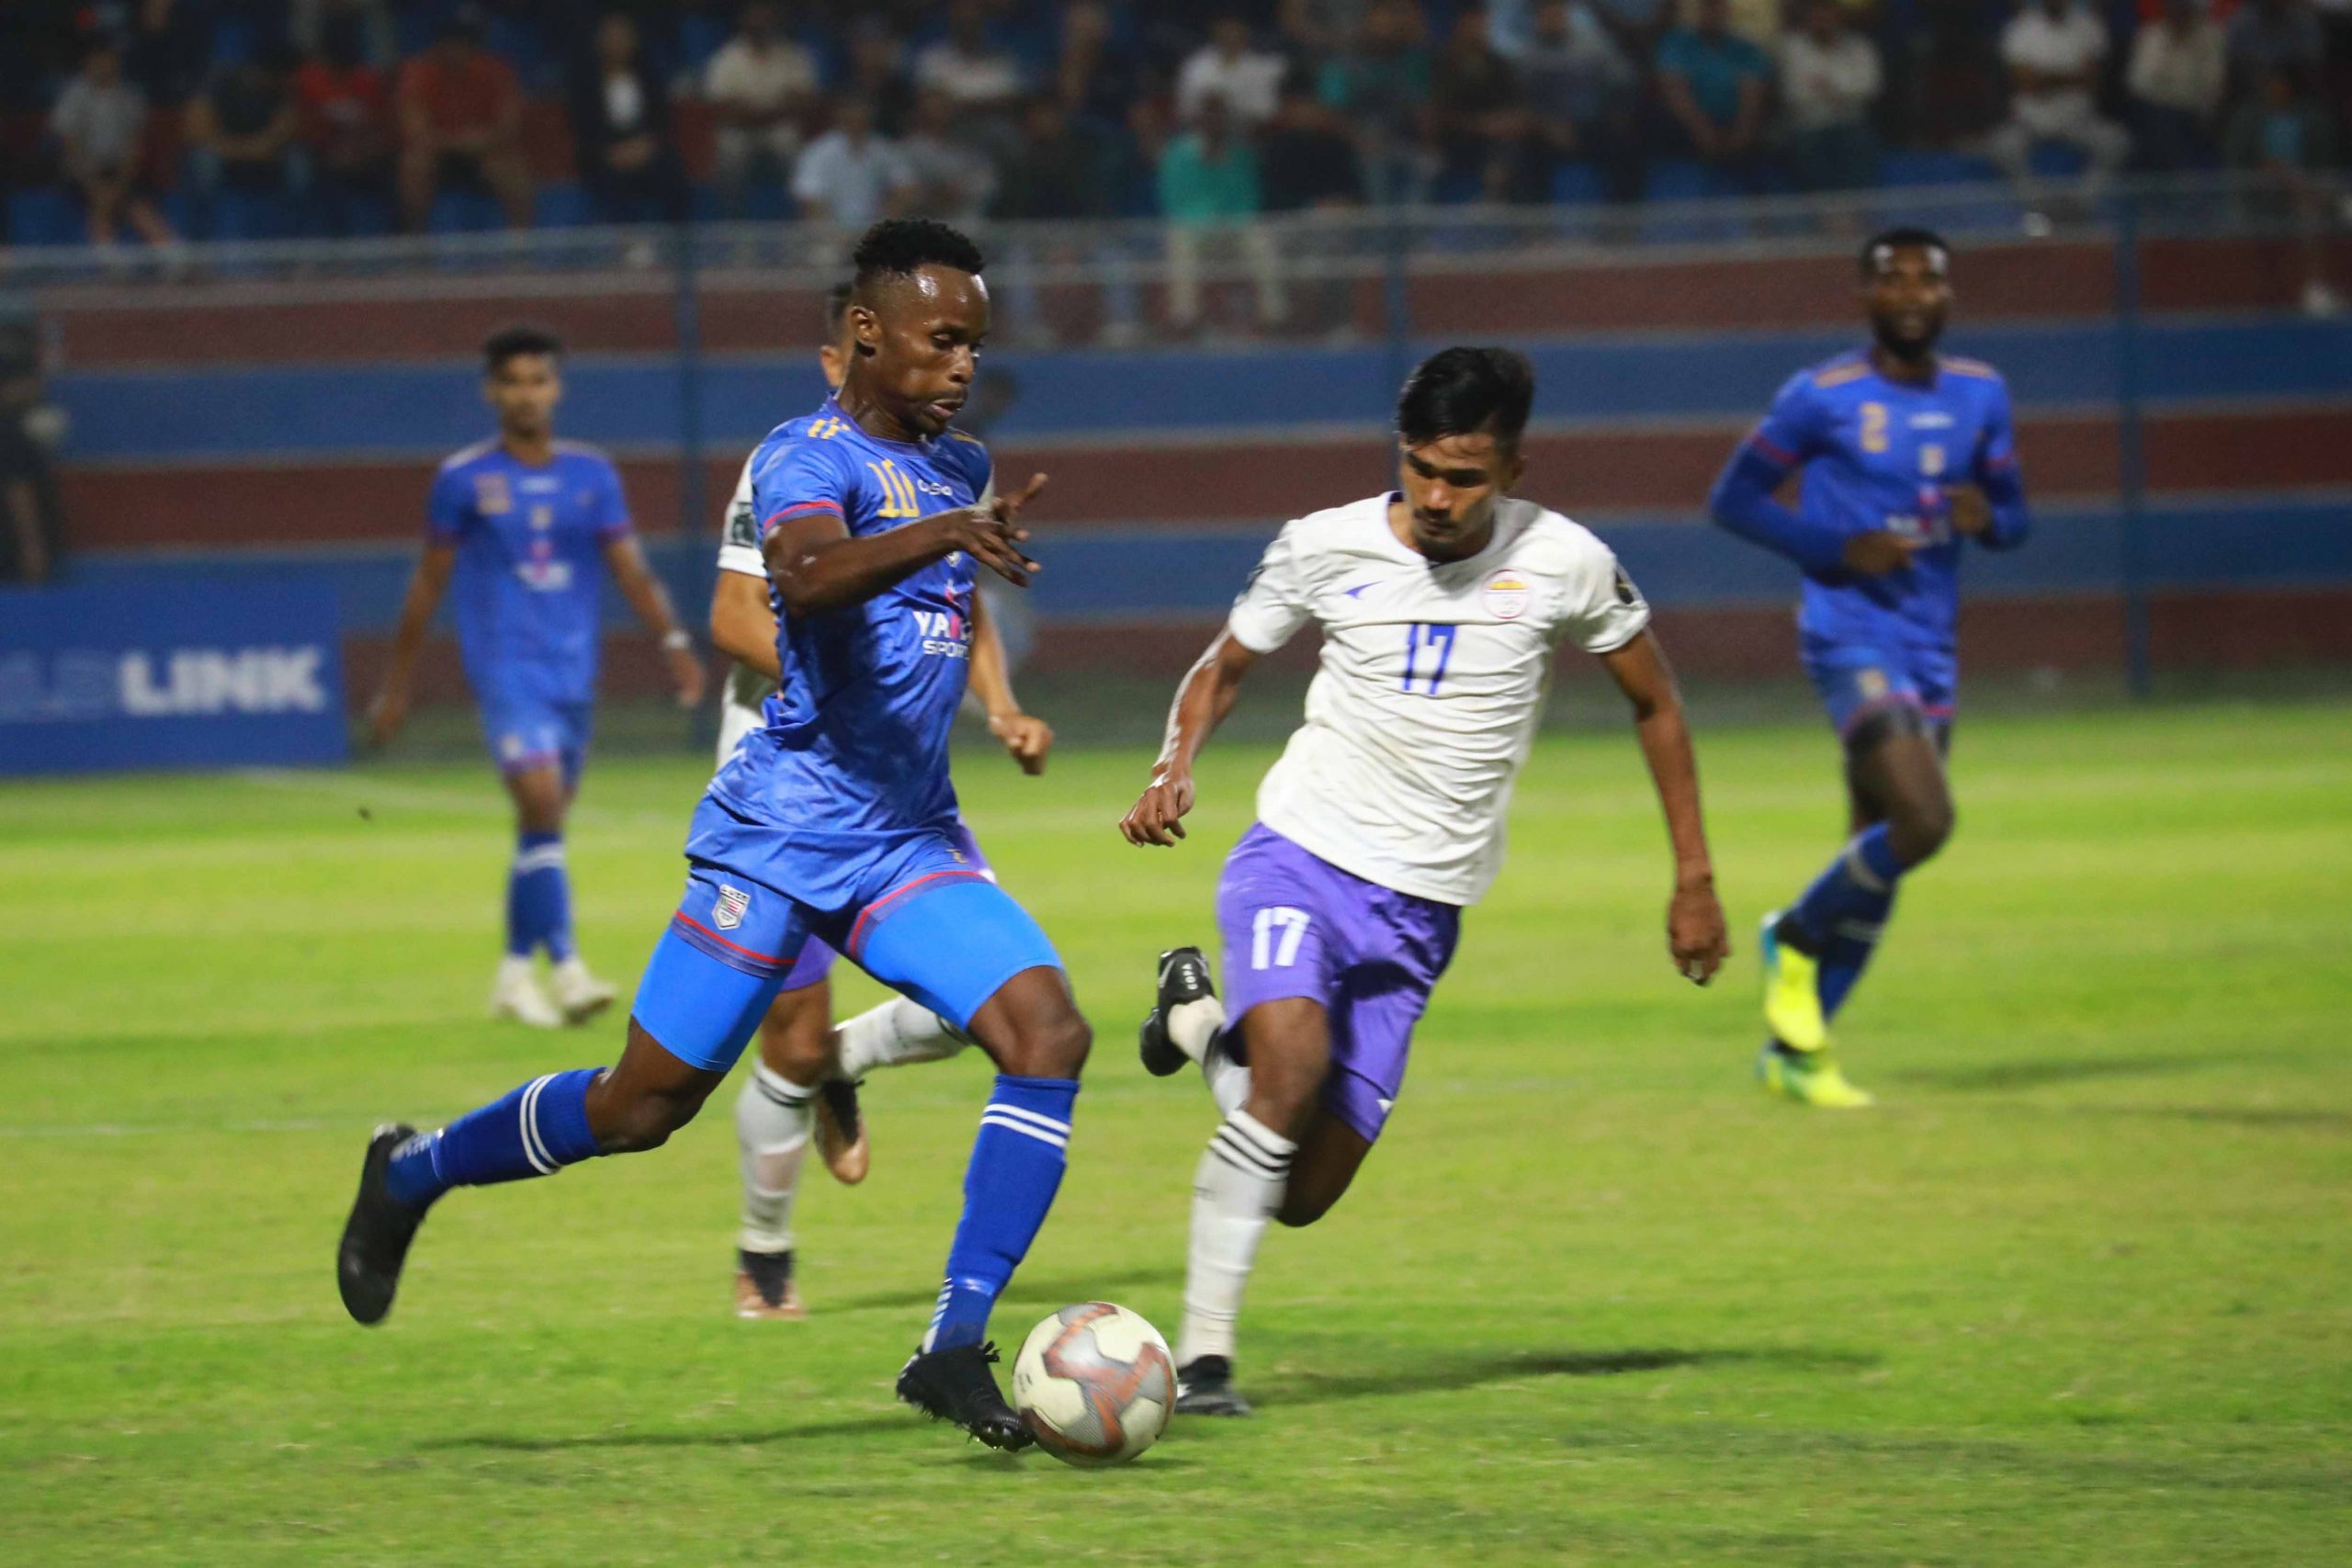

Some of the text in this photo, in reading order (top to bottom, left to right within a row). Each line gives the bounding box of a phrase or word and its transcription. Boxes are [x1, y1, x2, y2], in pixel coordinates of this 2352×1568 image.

[866, 458, 920, 517] 10
[119, 646, 326, 716] LINK
[1402, 622, 1456, 696] 17
[1250, 906, 1311, 970] 17
